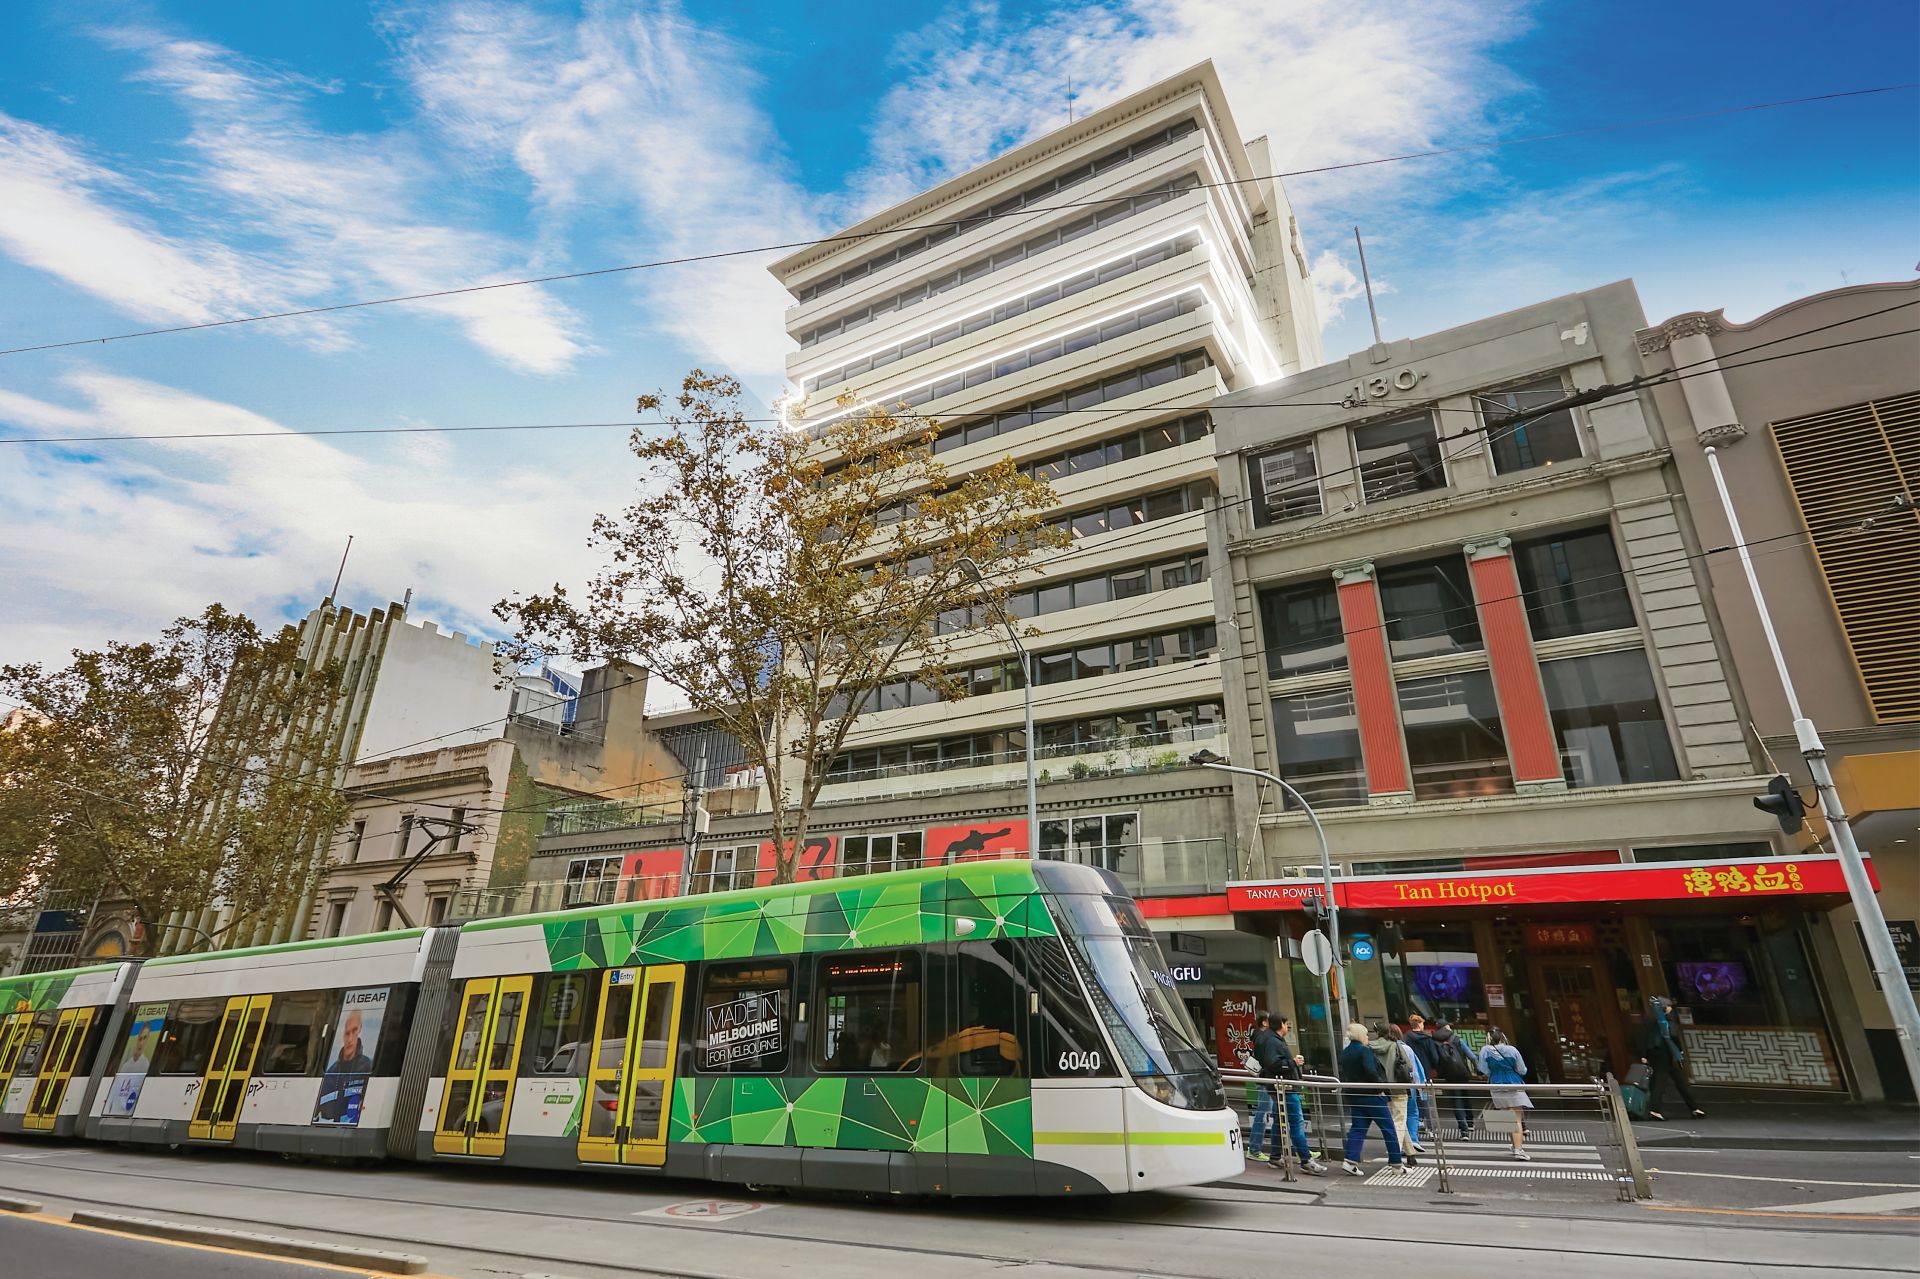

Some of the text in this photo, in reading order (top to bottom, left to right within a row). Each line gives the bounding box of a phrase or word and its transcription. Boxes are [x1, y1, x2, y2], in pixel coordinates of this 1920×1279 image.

[1354, 368, 1418, 401] 130
[1246, 887, 1324, 899] TANYA POWELL
[1394, 882, 1517, 903] Tan Hotpot
[620, 972, 634, 981] Entry
[1170, 967, 1201, 981] GFU
[357, 992, 387, 1004] GEAR
[147, 1007, 167, 1015] GEAR
[709, 995, 778, 1031] MADE IN
[709, 1019, 778, 1046] MELBOURNE
[709, 1037, 778, 1063] FOR MELBOURNE
[1058, 1051, 1101, 1070] 6040
